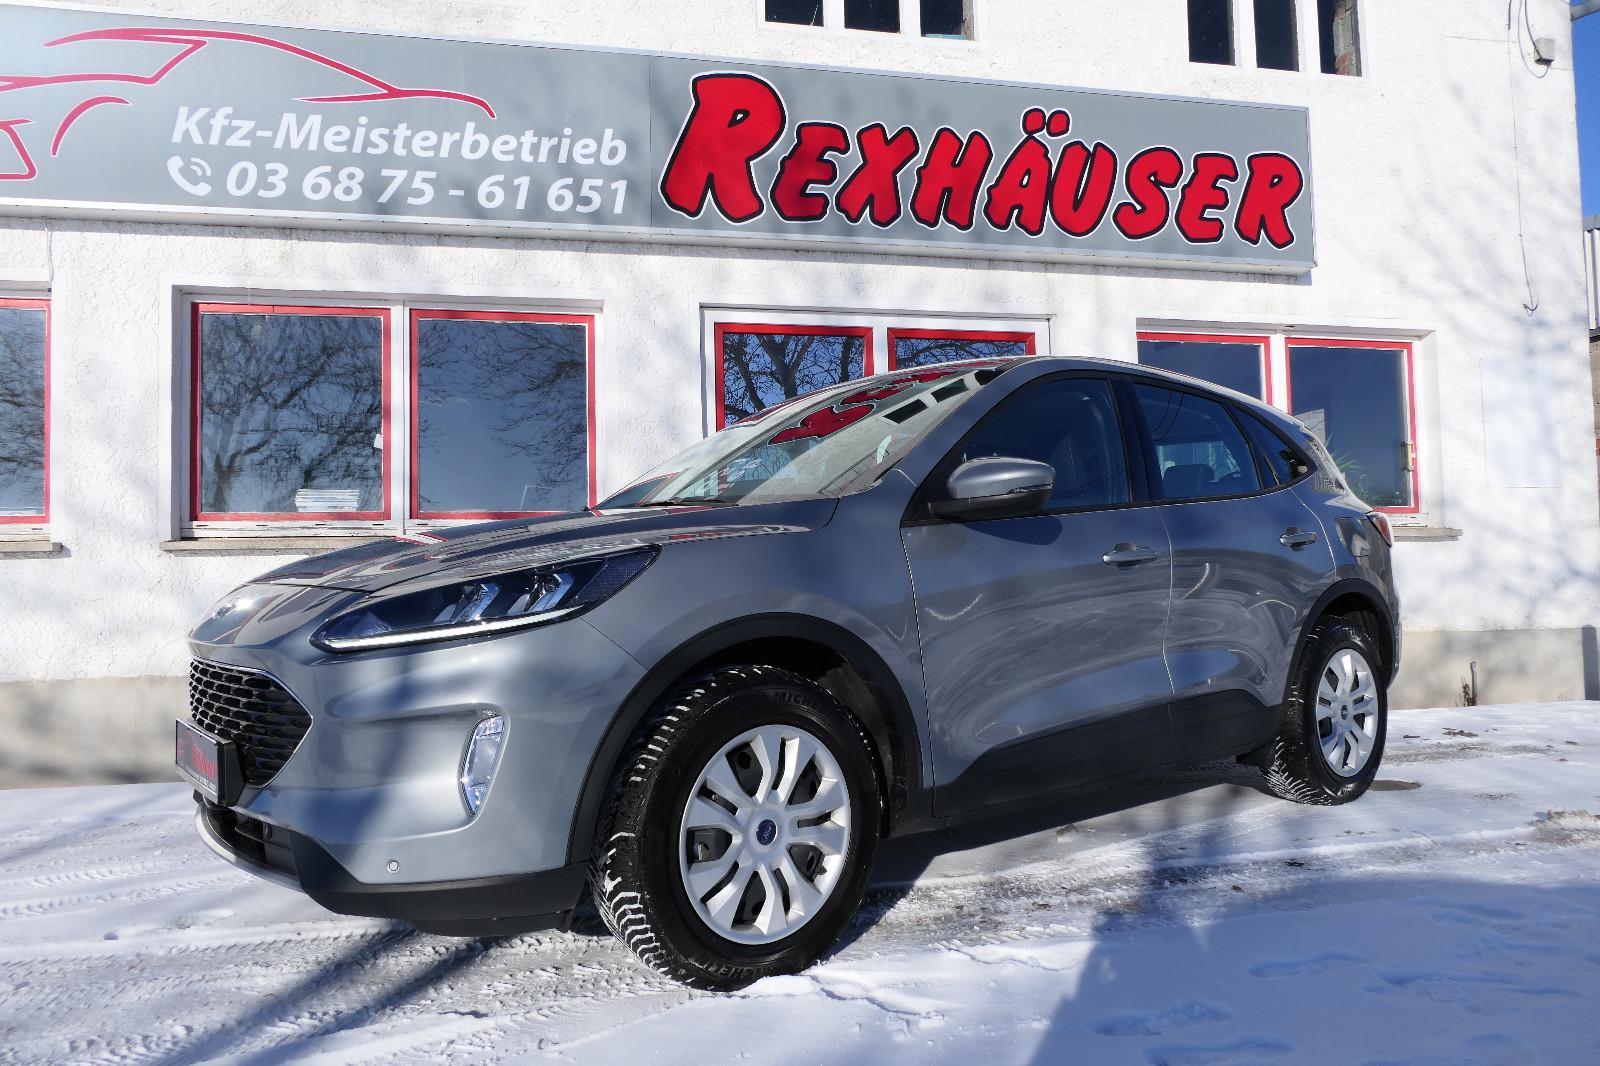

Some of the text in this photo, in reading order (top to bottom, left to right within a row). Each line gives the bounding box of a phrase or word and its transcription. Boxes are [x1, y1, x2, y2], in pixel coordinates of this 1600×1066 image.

[171, 105, 628, 166] Kfz-Meisterbetrieb
[661, 72, 1304, 249] REXHÄUSER
[226, 160, 289, 198] 03
[302, 165, 365, 202] 68
[378, 168, 438, 206] 75
[477, 174, 531, 210] 61
[546, 177, 628, 214] 651
